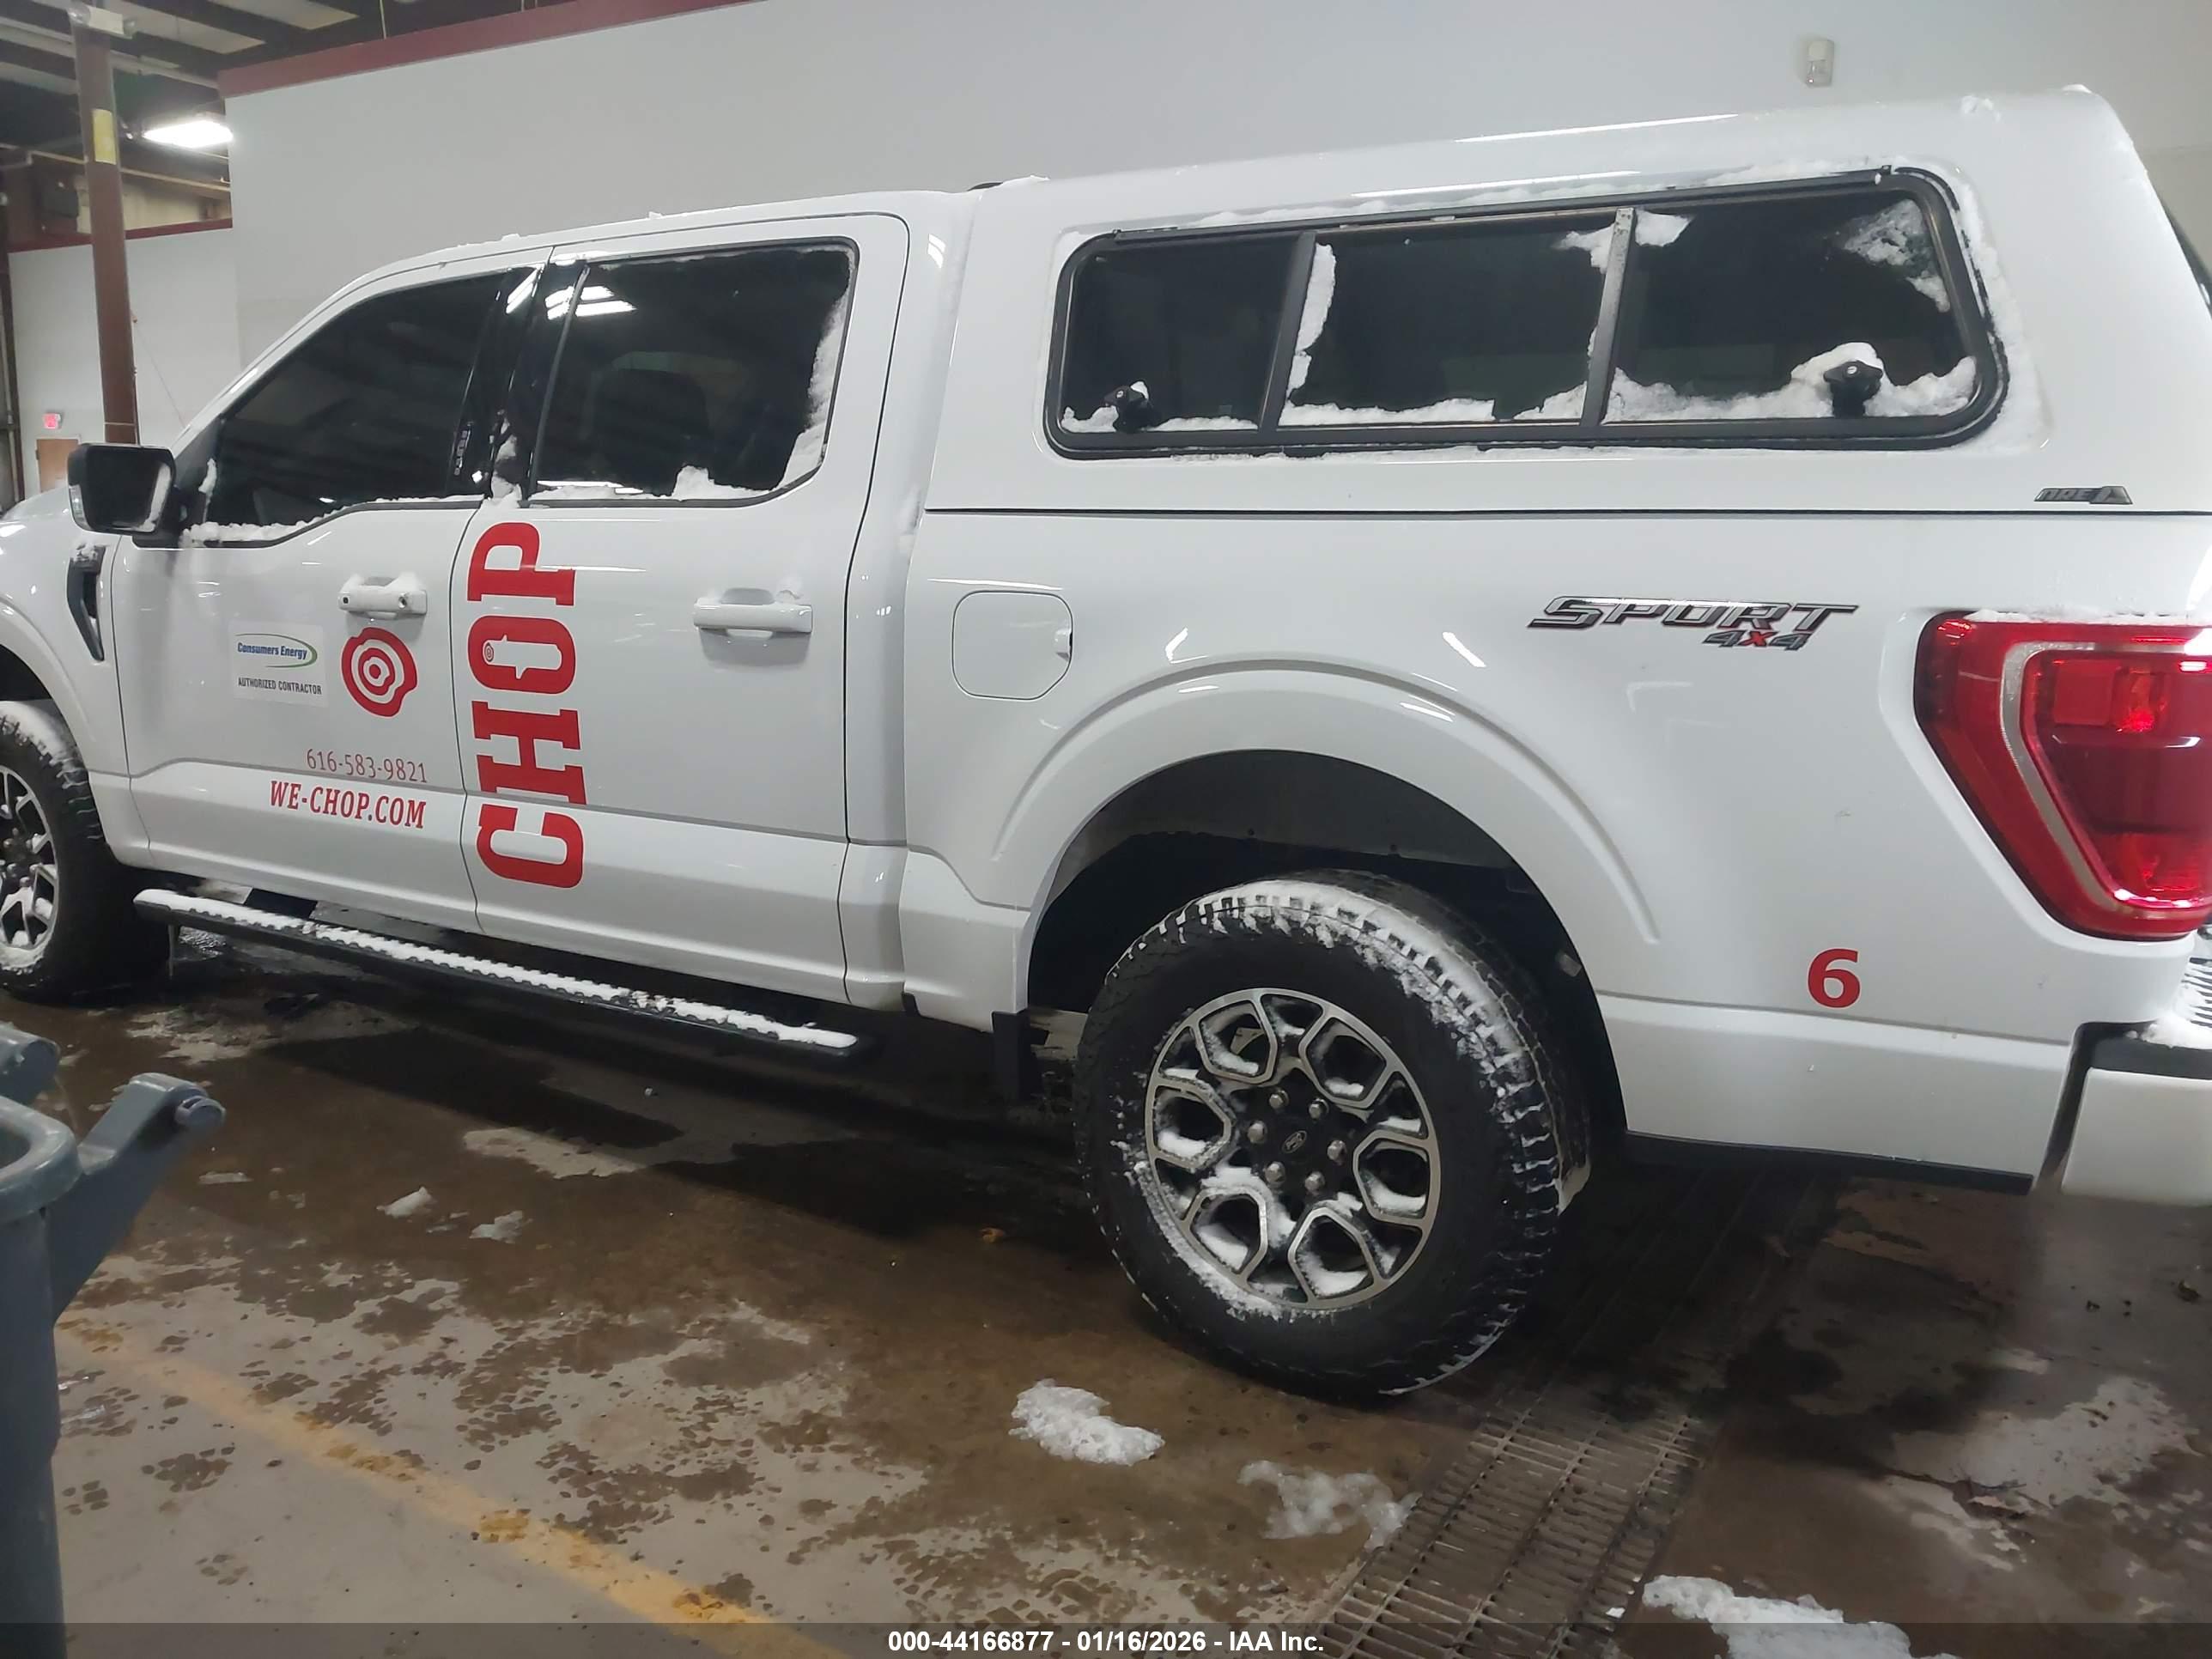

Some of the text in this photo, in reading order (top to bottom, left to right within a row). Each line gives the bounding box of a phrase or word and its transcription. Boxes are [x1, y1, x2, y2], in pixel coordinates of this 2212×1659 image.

[1527, 595, 1859, 631] SPORT
[237, 641, 307, 660] Consumers Energy
[238, 677, 322, 696] AUTHORIZED CONTRACTOR
[466, 521, 587, 889] CHOP
[306, 748, 428, 783] 616-583-9821
[270, 780, 427, 830] WE-CHOP.COM
[1807, 947, 1861, 1008] 6
